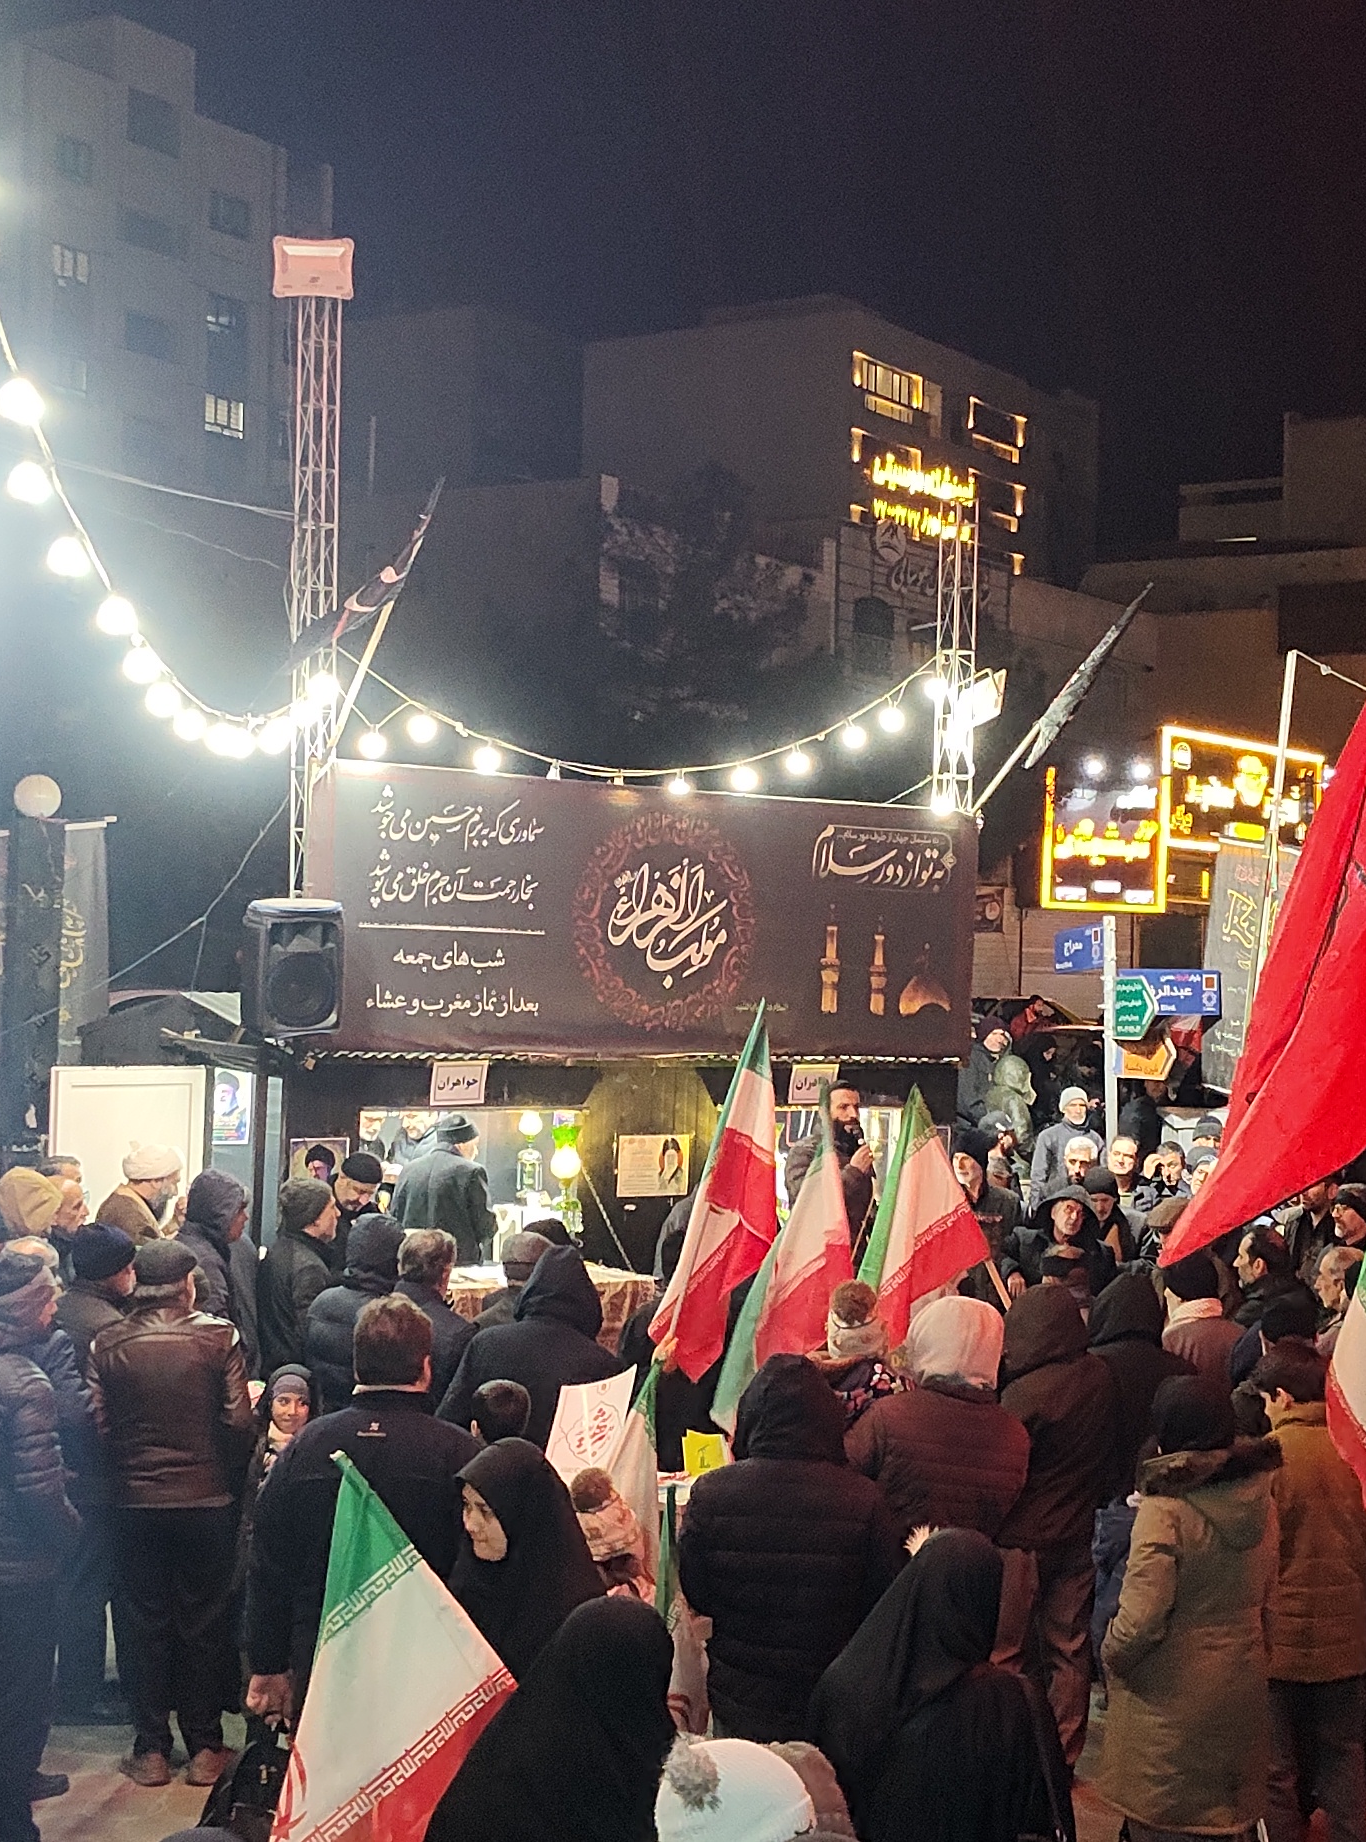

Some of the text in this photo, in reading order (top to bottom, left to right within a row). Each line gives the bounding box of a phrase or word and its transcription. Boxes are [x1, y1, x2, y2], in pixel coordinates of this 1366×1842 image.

[408, 804, 475, 847] حسین
[464, 806, 483, 851] بزم
[481, 826, 490, 847] به
[812, 824, 946, 893] به تو از دور سلام
[399, 861, 431, 902] خلق
[424, 870, 450, 908] جرم
[439, 866, 471, 903] آن
[456, 876, 517, 901] رحمت
[393, 948, 432, 973] جمعه
[1063, 939, 1083, 957] معراج
[405, 997, 420, 1015] و
[421, 993, 471, 1017] مغرب
[469, 986, 498, 1017] نماز
[495, 987, 514, 1017] از
[513, 995, 539, 1016] بعد
